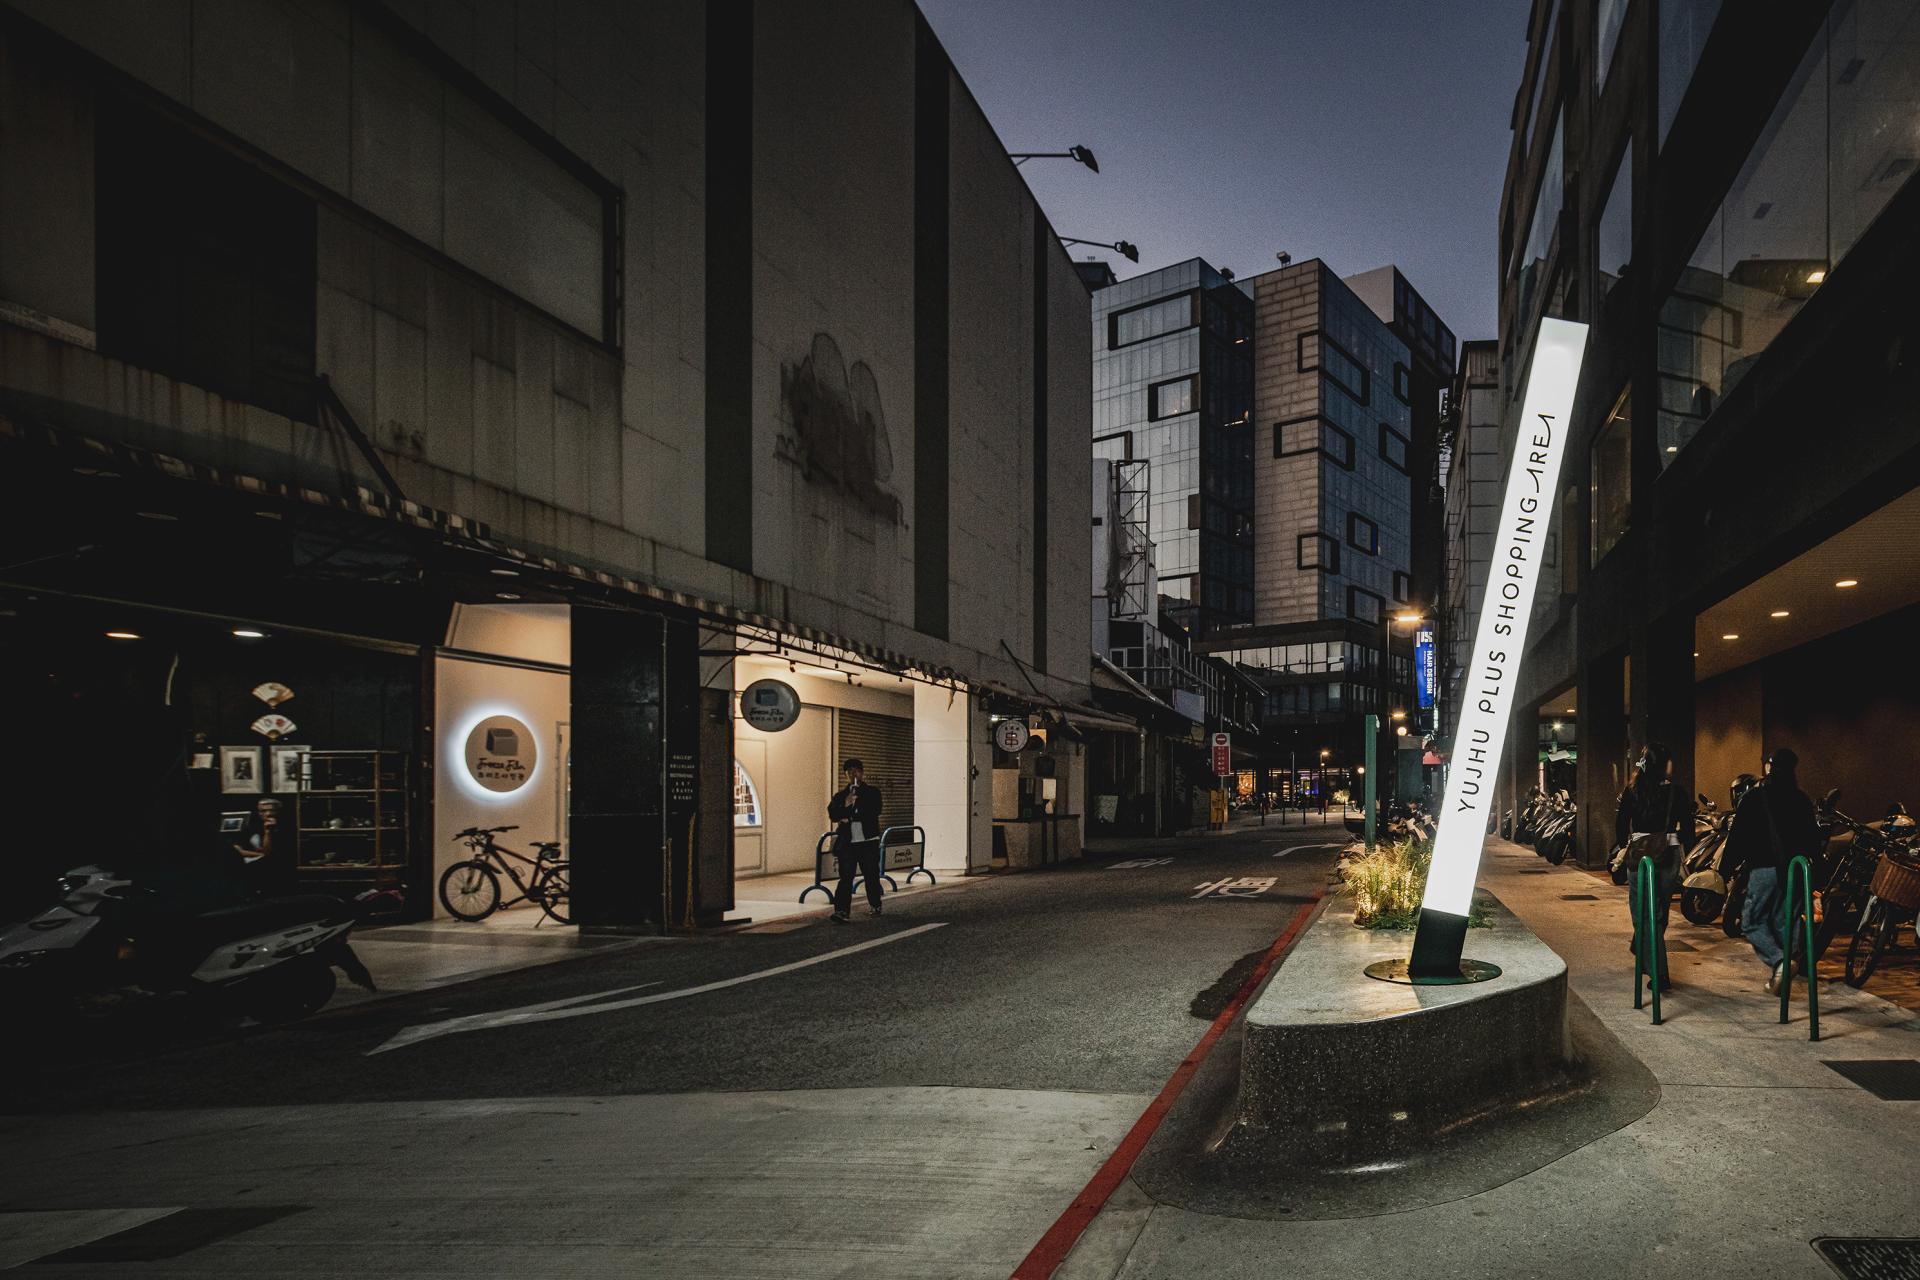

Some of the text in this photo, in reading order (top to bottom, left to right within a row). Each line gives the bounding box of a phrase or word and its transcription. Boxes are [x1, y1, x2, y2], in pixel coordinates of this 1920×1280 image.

[1457, 413, 1555, 812] YUJHU PLUS SHOPPING AREA
[1190, 877, 1279, 899] 慢
